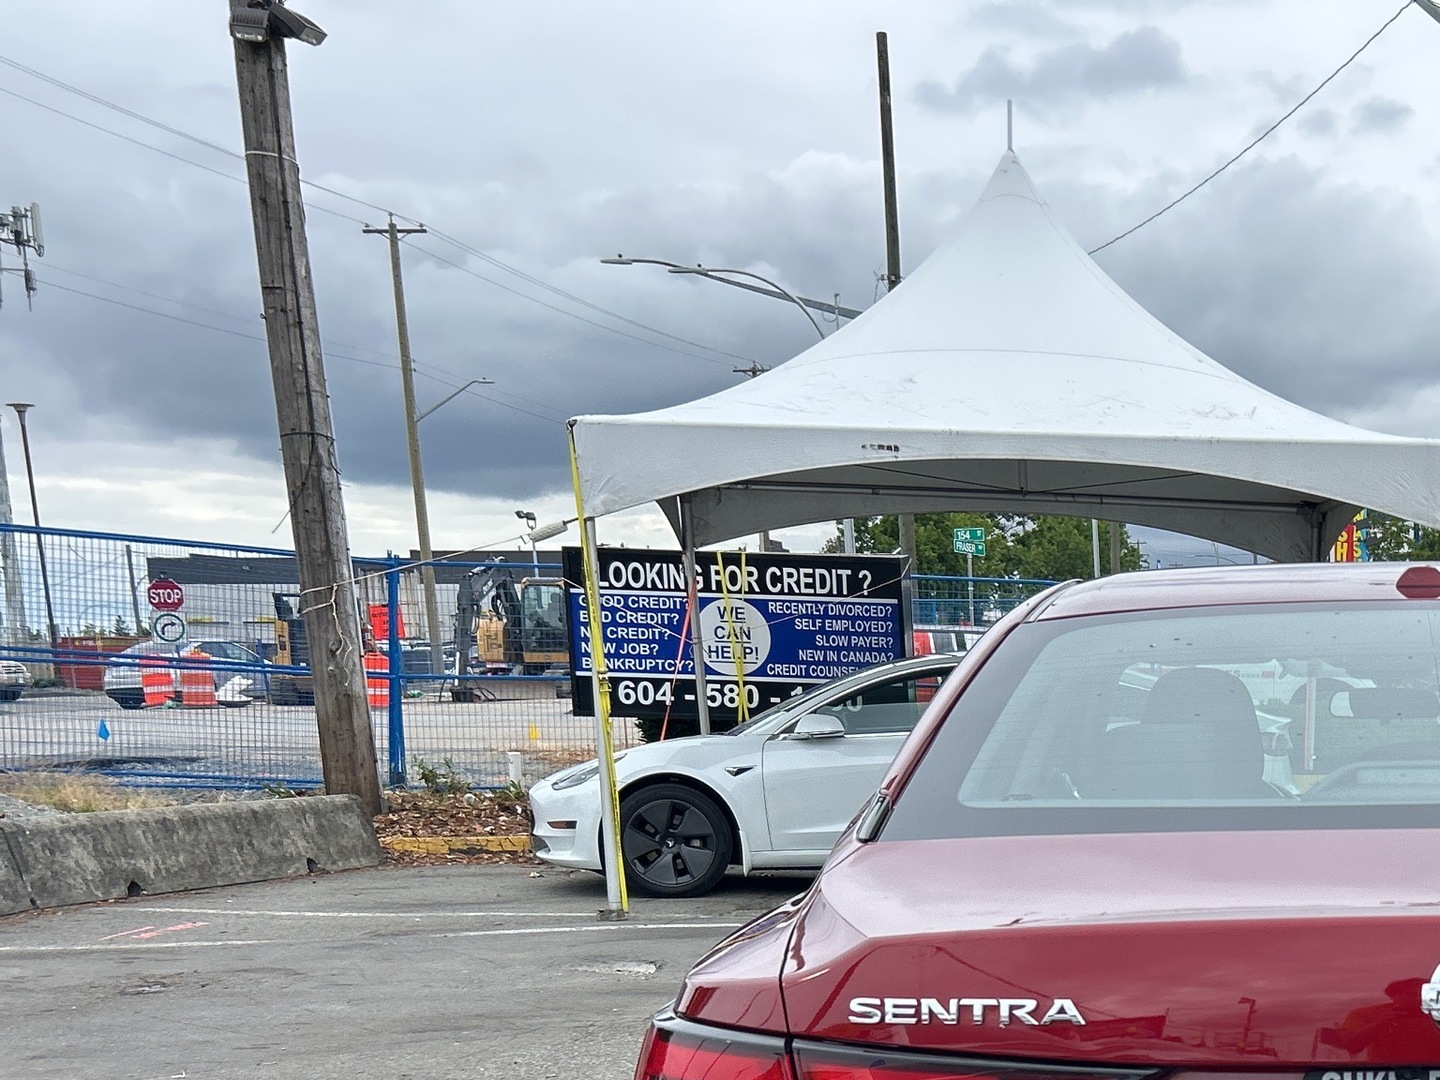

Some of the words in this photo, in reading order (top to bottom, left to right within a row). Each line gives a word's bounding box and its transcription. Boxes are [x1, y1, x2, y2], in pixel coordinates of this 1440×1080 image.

[957, 530, 970, 540] 154
[956, 541, 976, 552] FRASER
[710, 564, 761, 592] FOR
[765, 566, 852, 595] CREDIT
[149, 588, 182, 604] STOP
[578, 594, 624, 608] GOD
[628, 596, 690, 610] CREDIT?
[717, 606, 745, 620] WE
[768, 602, 825, 615] RECENTLY
[828, 603, 892, 617] DIVORCED?
[580, 610, 612, 623] BD
[615, 611, 680, 625] CREDIT?
[714, 625, 751, 640] CAN
[794, 618, 823, 631] SELF
[825, 619, 893, 633] EMPLOYED?
[606, 627, 670, 640] CREDIT?
[815, 634, 848, 647] SLOW
[851, 636, 894, 648] PAYER?
[581, 641, 617, 654] NW
[619, 643, 659, 656] JOB?
[582, 657, 694, 671] BNKRUPTCY?
[799, 649, 826, 662] NEW
[826, 650, 838, 662] IN
[840, 651, 894, 664] CANADA?
[767, 663, 806, 676] CREDIT
[618, 680, 674, 706] 604
[706, 683, 760, 709] 580
[848, 997, 1086, 1026] SENTRA
